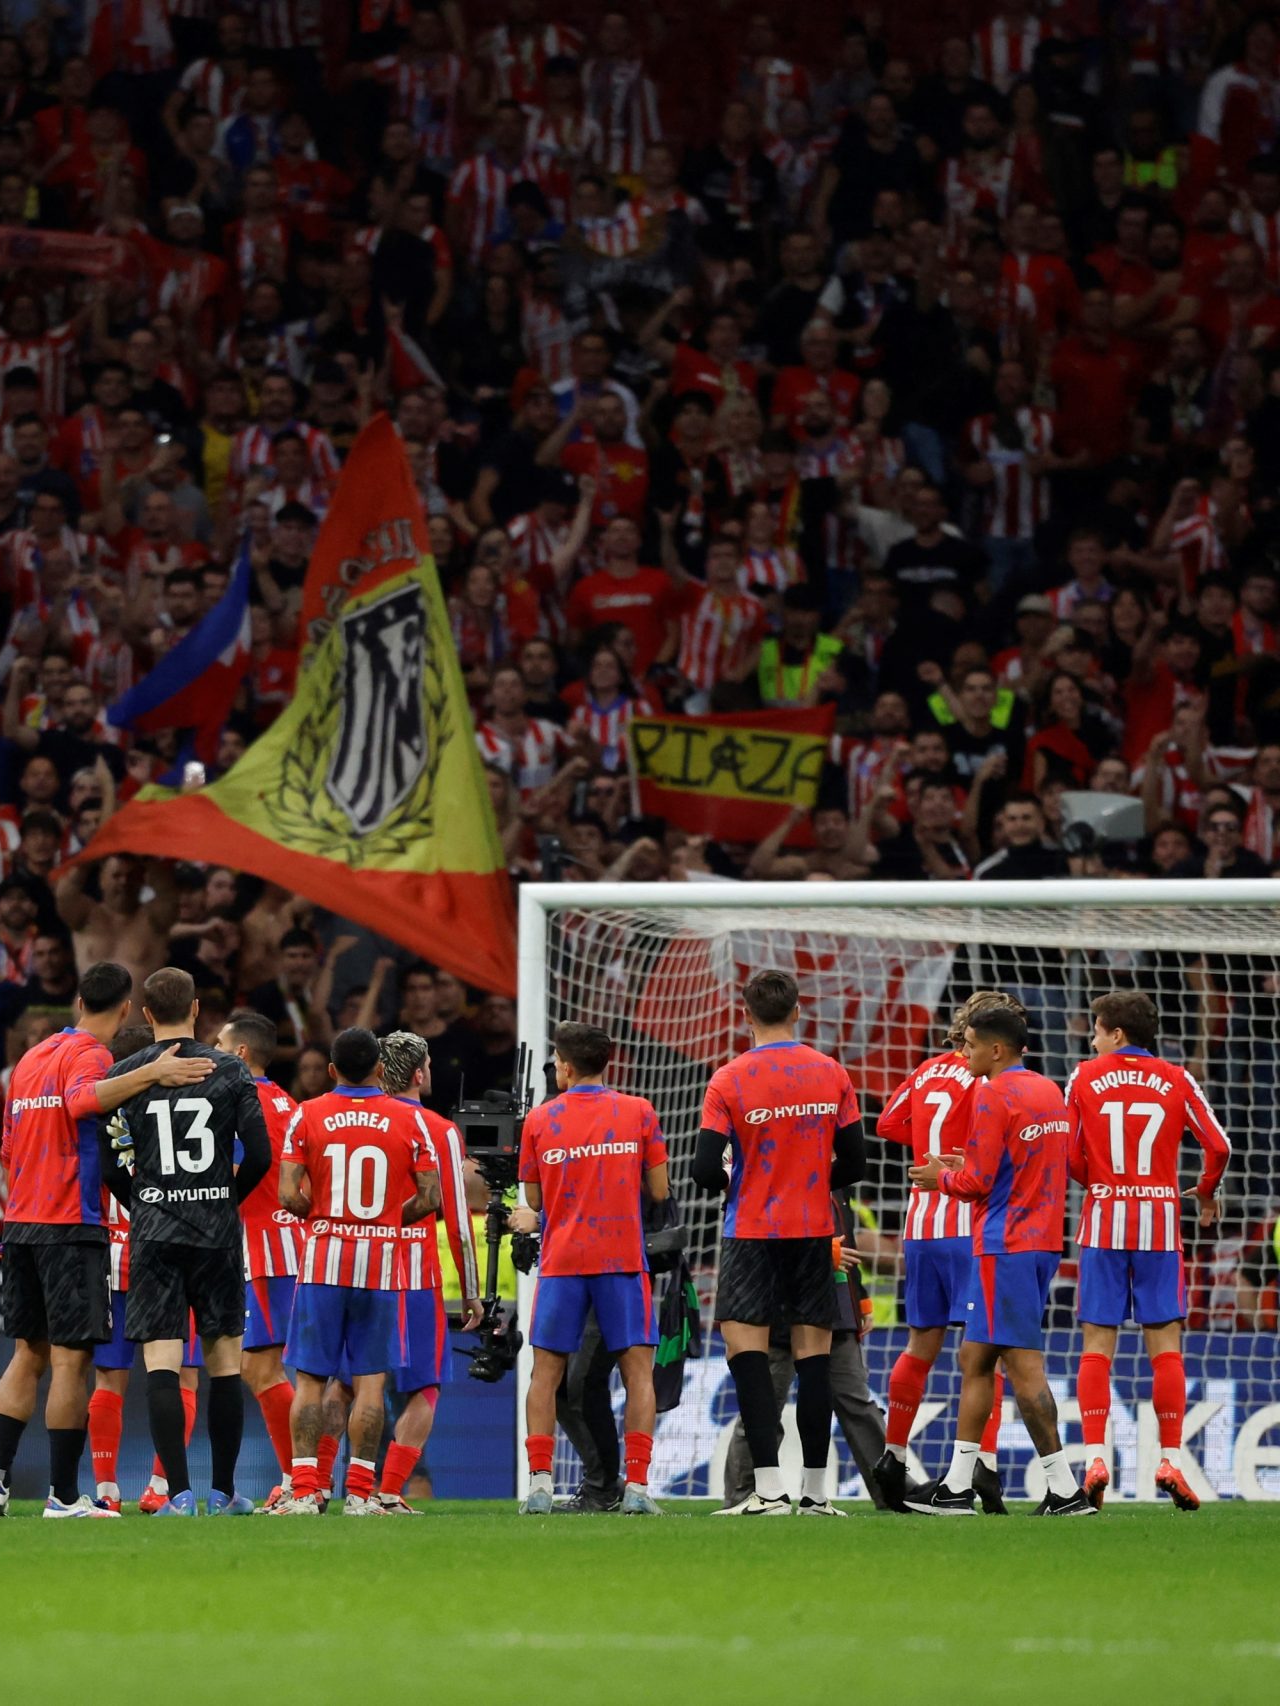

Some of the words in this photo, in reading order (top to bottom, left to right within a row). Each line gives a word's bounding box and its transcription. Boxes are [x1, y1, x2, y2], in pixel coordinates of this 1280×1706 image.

[1090, 1070, 1173, 1096] RIQUELME
[774, 1103, 838, 1118] HYUNDAI
[323, 1111, 390, 1133] CORREA
[924, 1091, 953, 1157] 7
[146, 1098, 215, 1175] 13
[1099, 1101, 1166, 1176] 17
[570, 1142, 638, 1159] HYUNDAI
[323, 1143, 388, 1219] 10
[167, 1187, 230, 1202] HYUNDAI
[1115, 1186, 1176, 1199] HYUNDAI
[332, 1224, 397, 1238] HYUNDA
